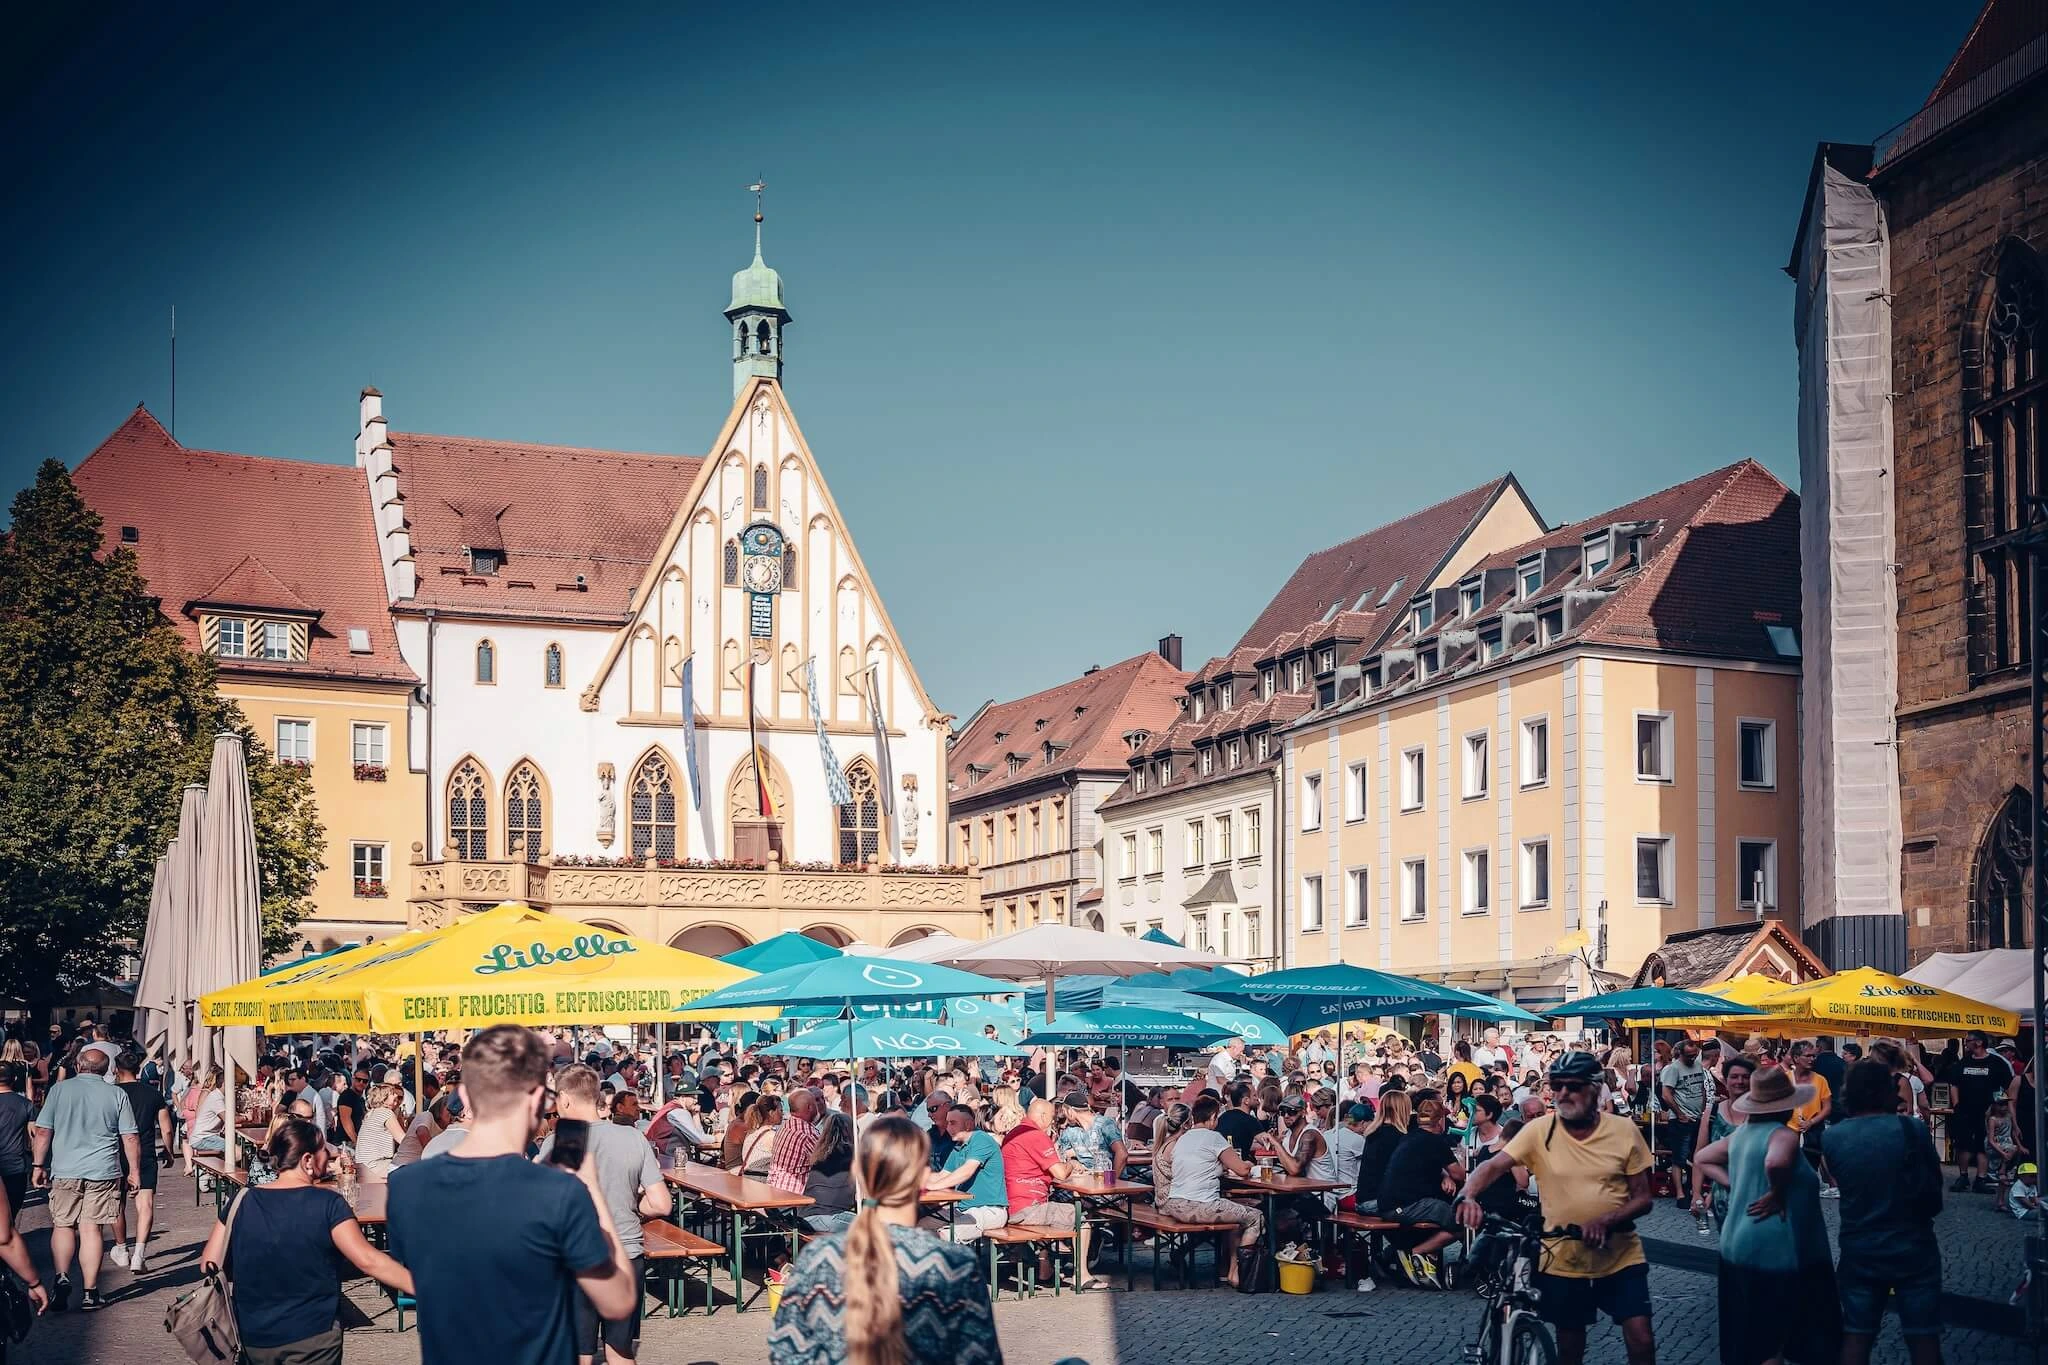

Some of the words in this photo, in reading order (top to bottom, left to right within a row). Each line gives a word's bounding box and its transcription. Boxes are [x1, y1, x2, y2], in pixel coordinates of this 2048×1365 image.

[474, 934, 638, 975] Libella
[1859, 984, 1940, 997] Libella
[1966, 1014, 1985, 1025] SEIT
[1988, 1015, 2006, 1028] 1951
